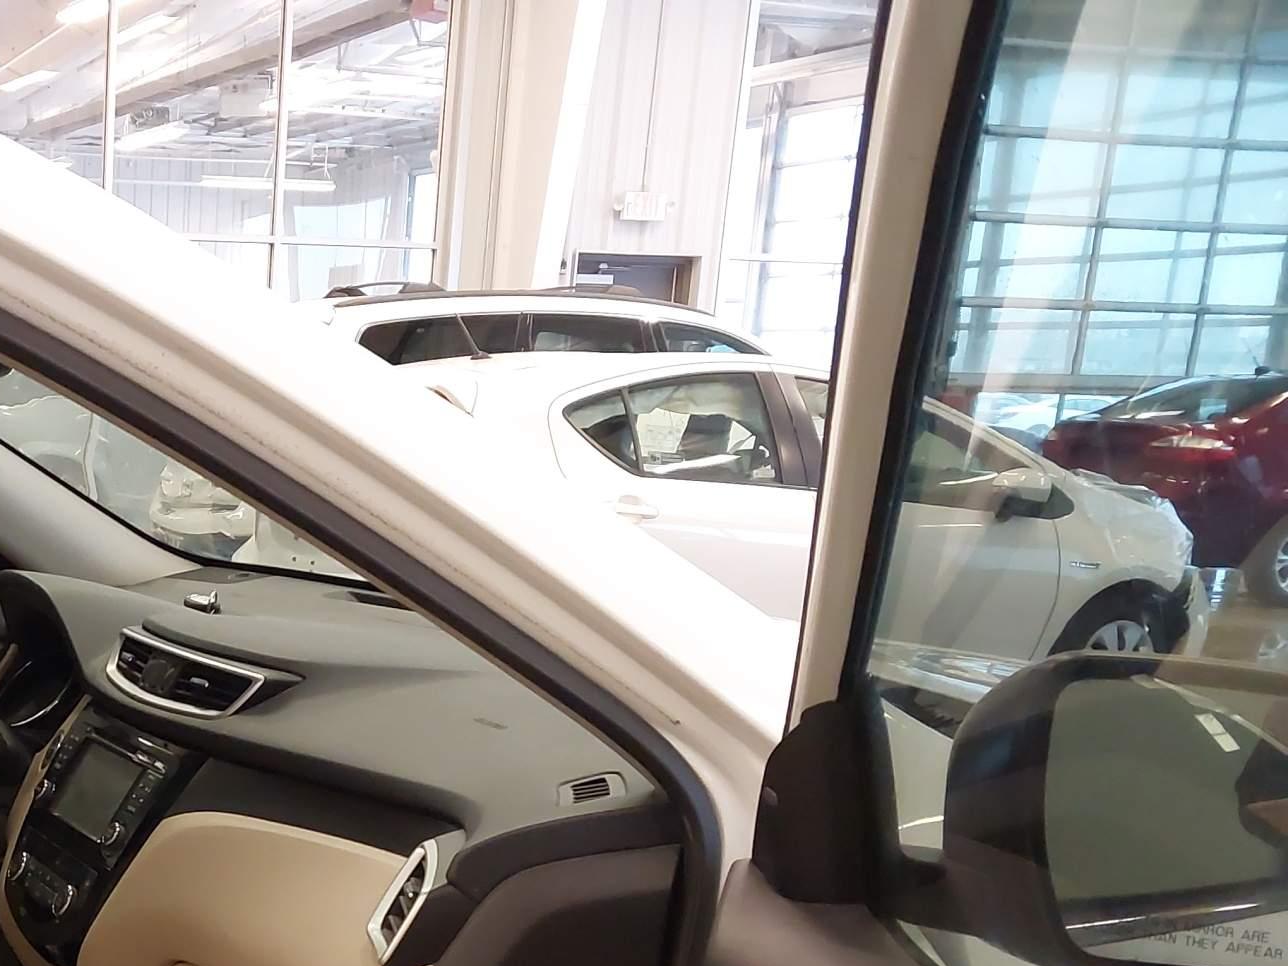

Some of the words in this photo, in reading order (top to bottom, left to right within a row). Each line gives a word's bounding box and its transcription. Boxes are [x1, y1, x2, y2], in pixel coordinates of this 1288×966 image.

[1240, 929, 1272, 943] ARE
[1185, 935, 1218, 950] THEY
[1224, 941, 1283, 960] APPEAR
